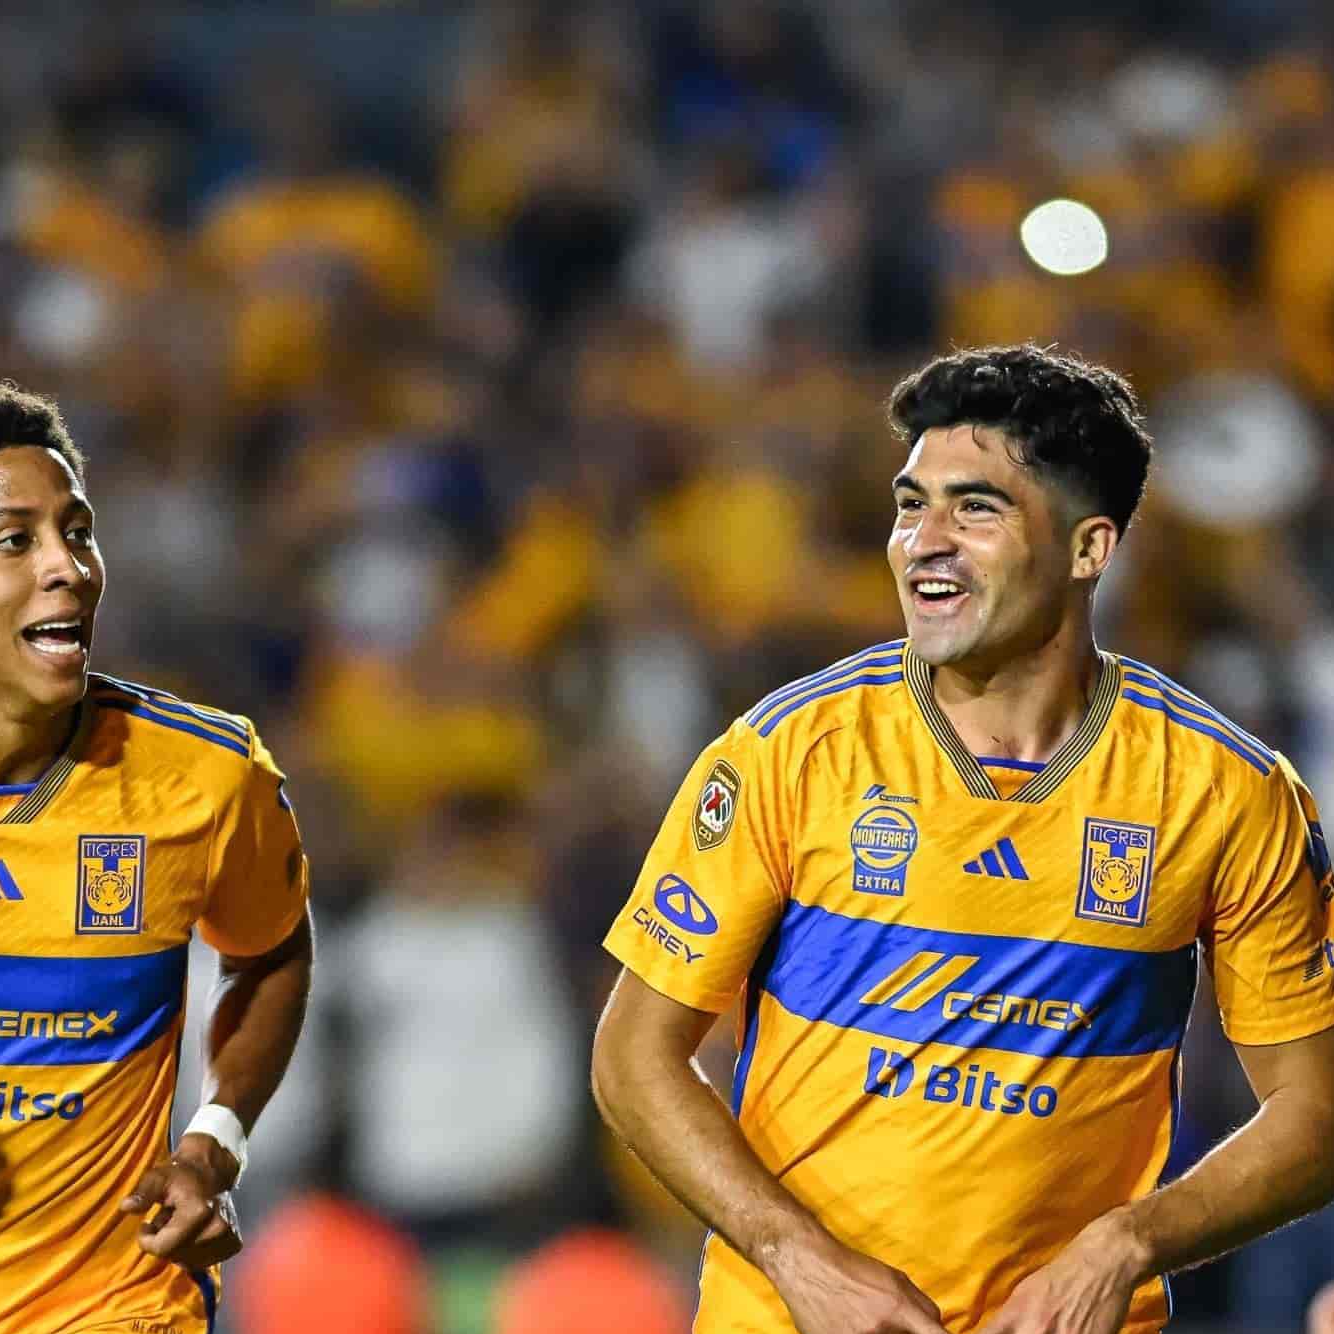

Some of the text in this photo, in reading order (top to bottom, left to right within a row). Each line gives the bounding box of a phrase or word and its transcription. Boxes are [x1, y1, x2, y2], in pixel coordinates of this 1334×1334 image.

[851, 828, 916, 850] MONTERREY
[1091, 826, 1148, 848] TIGRES
[84, 842, 137, 857] TIGRES
[856, 875, 901, 892] EXTRA
[1094, 900, 1128, 917] UANL
[91, 915, 125, 927] UANL
[633, 907, 705, 964] CHIREY
[941, 991, 1099, 1032] CEMEX
[923, 1063, 1058, 1118] Bitso
